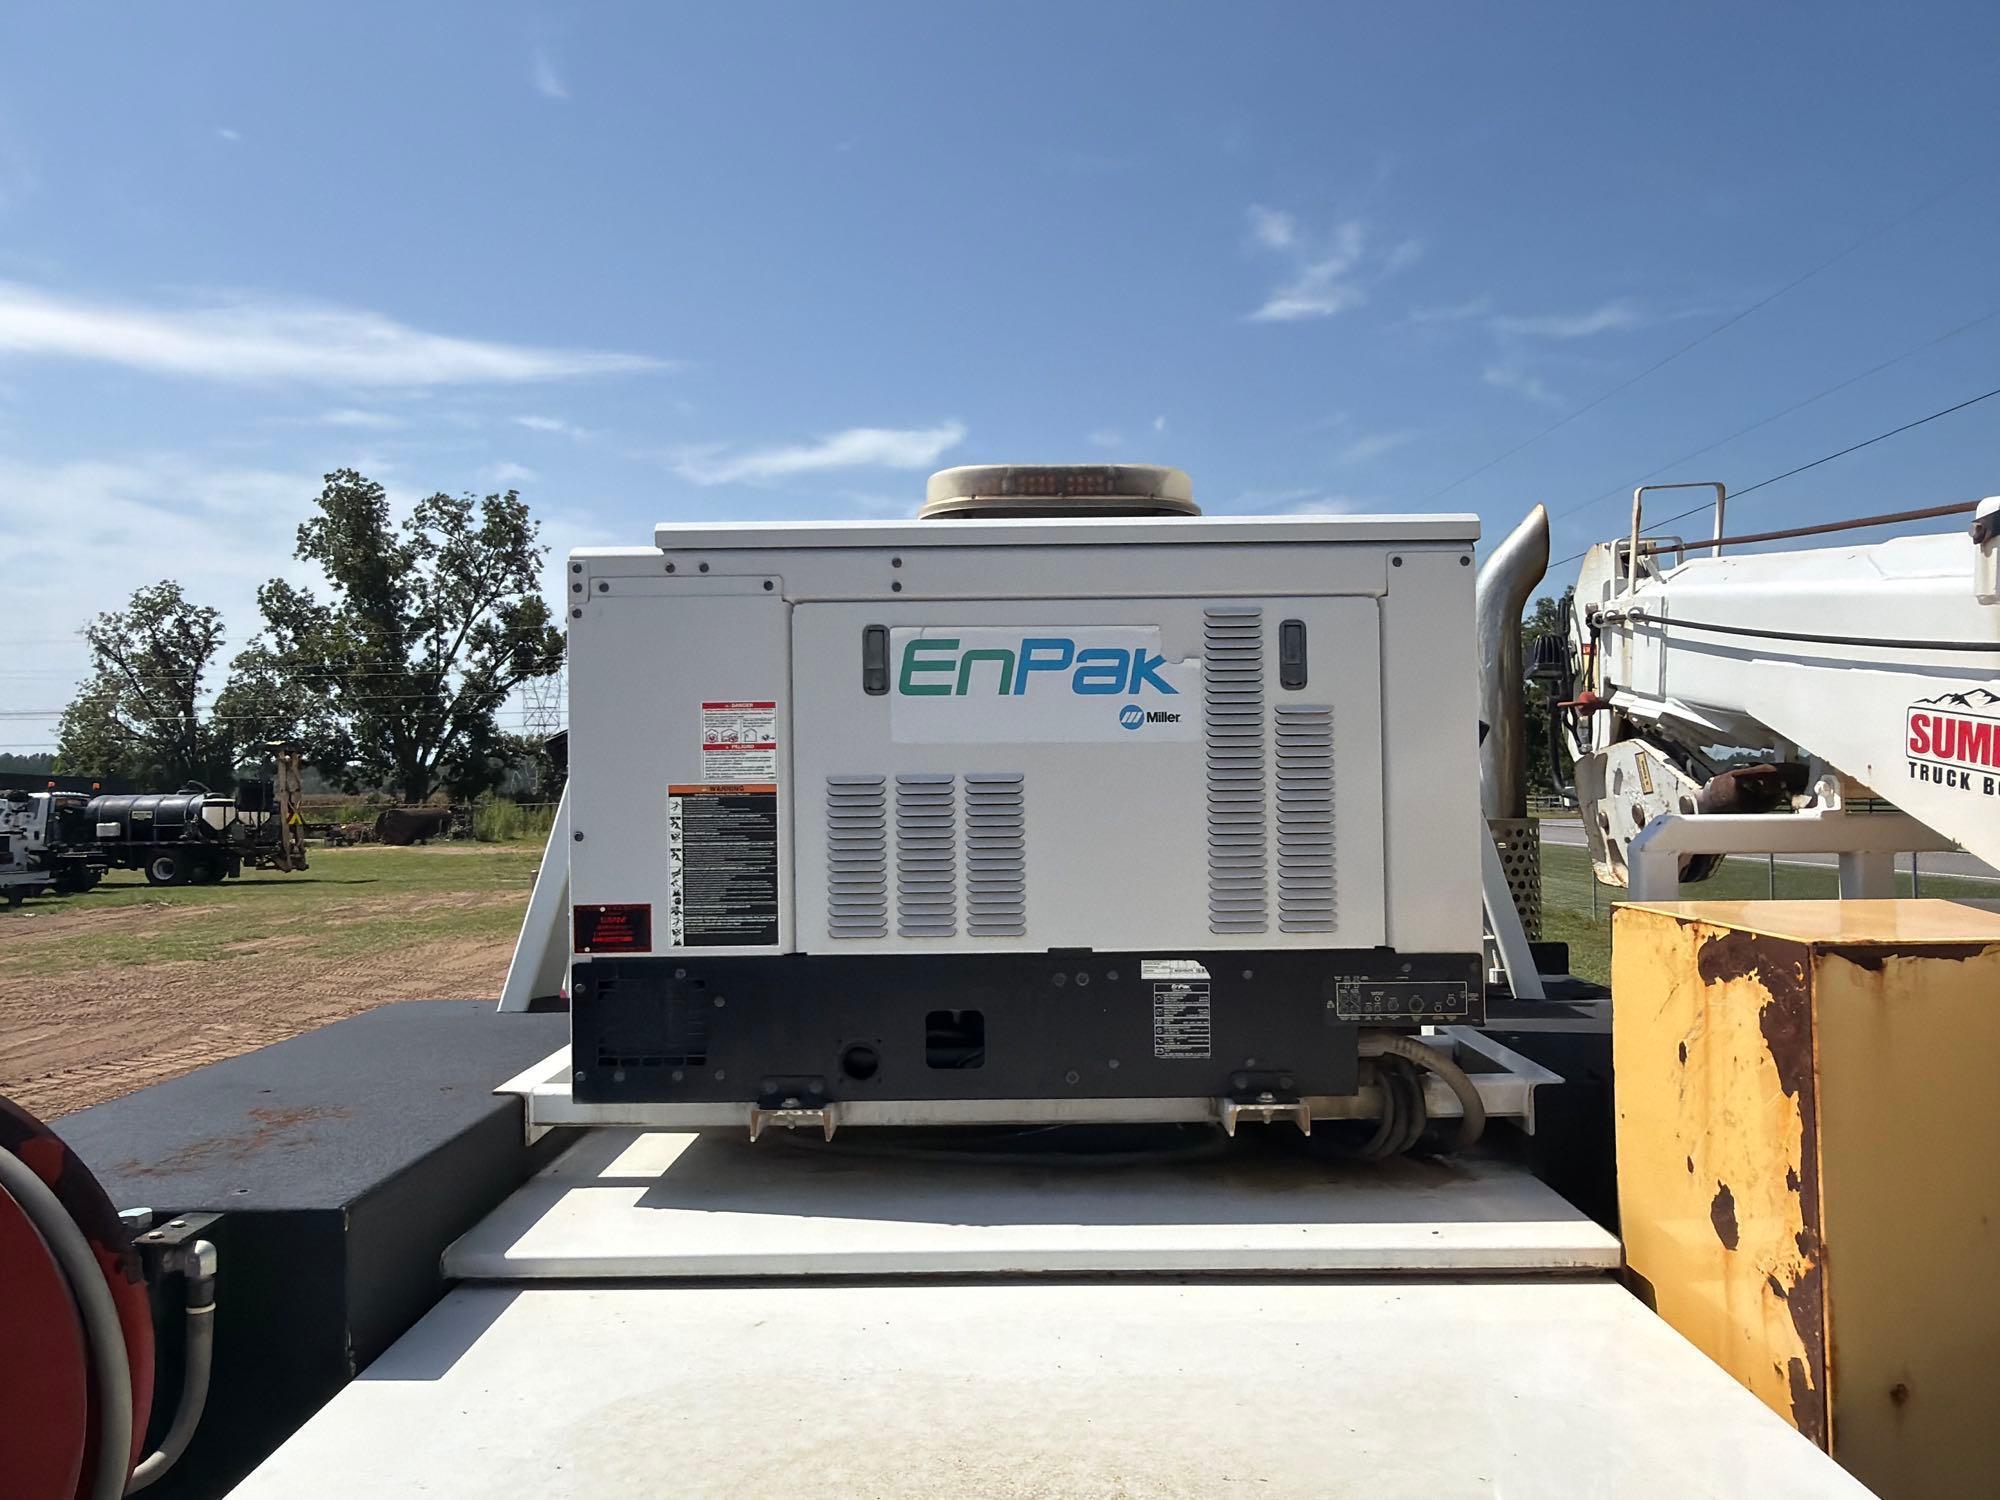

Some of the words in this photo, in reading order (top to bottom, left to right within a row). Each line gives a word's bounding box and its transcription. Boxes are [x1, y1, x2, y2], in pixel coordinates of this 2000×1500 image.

[898, 638, 1180, 696] EnPak
[1146, 711, 1181, 723] Miller
[1909, 713, 2000, 768] SUM
[1908, 761, 1970, 790] TRUCK
[1983, 776, 2000, 795] B
